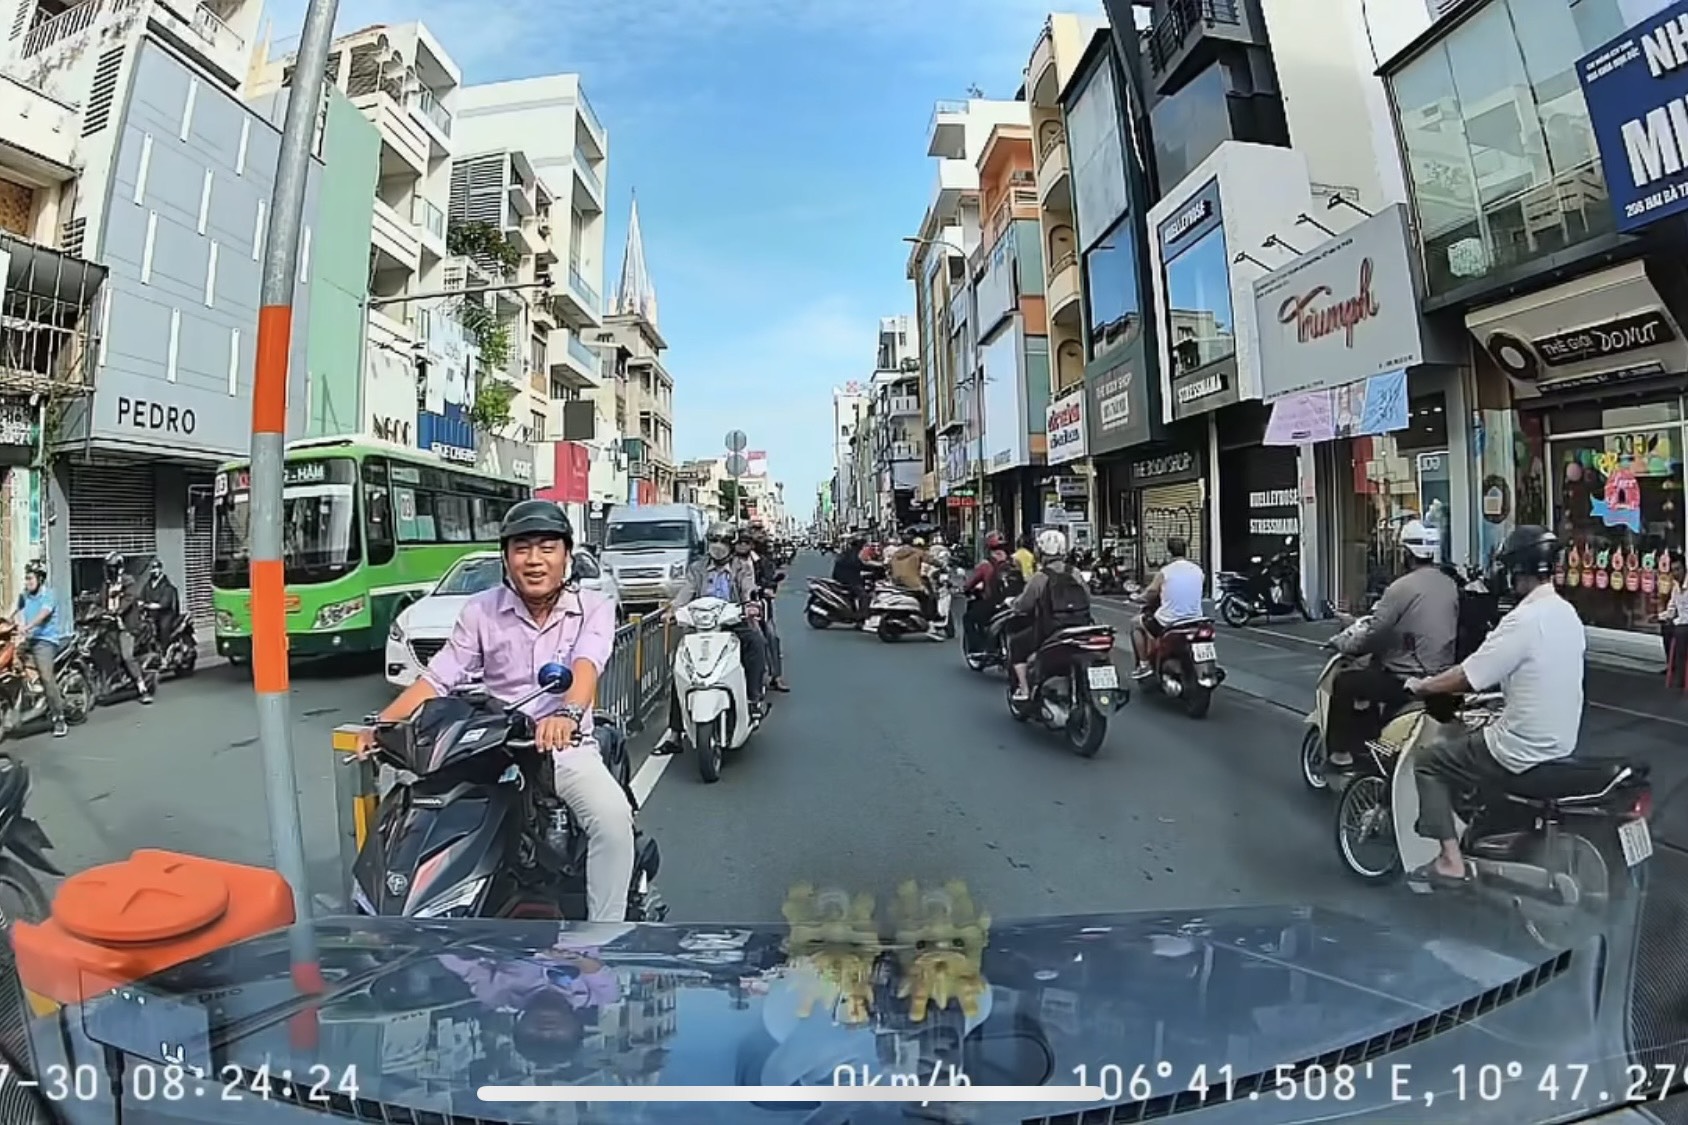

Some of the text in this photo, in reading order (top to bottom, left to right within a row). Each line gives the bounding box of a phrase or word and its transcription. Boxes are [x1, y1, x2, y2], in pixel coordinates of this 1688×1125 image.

[1278, 257, 1381, 349] Triumph
[1591, 321, 1659, 352] DONUT
[118, 396, 196, 435] PEDRO
